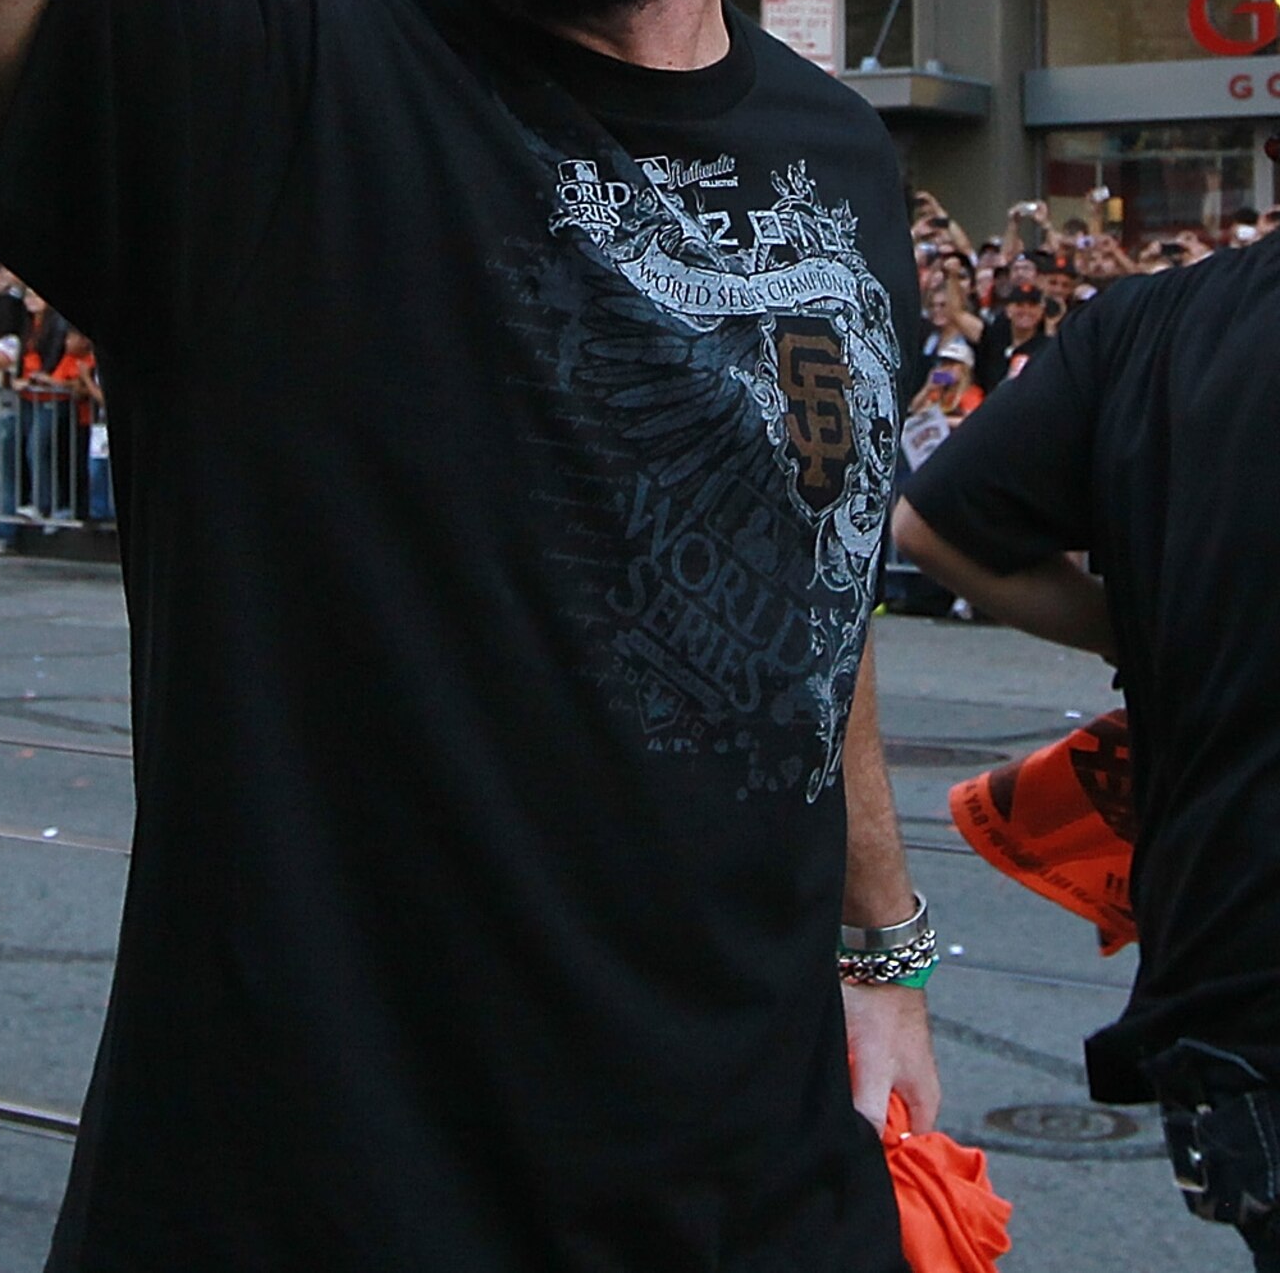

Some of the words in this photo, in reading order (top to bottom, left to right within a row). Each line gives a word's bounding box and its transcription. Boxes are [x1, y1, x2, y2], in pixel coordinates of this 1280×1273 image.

[556, 182, 631, 206] ORLD
[569, 203, 621, 227] ERIES
[639, 261, 711, 307] WORLD
[767, 270, 852, 302] CHAMPIONS
